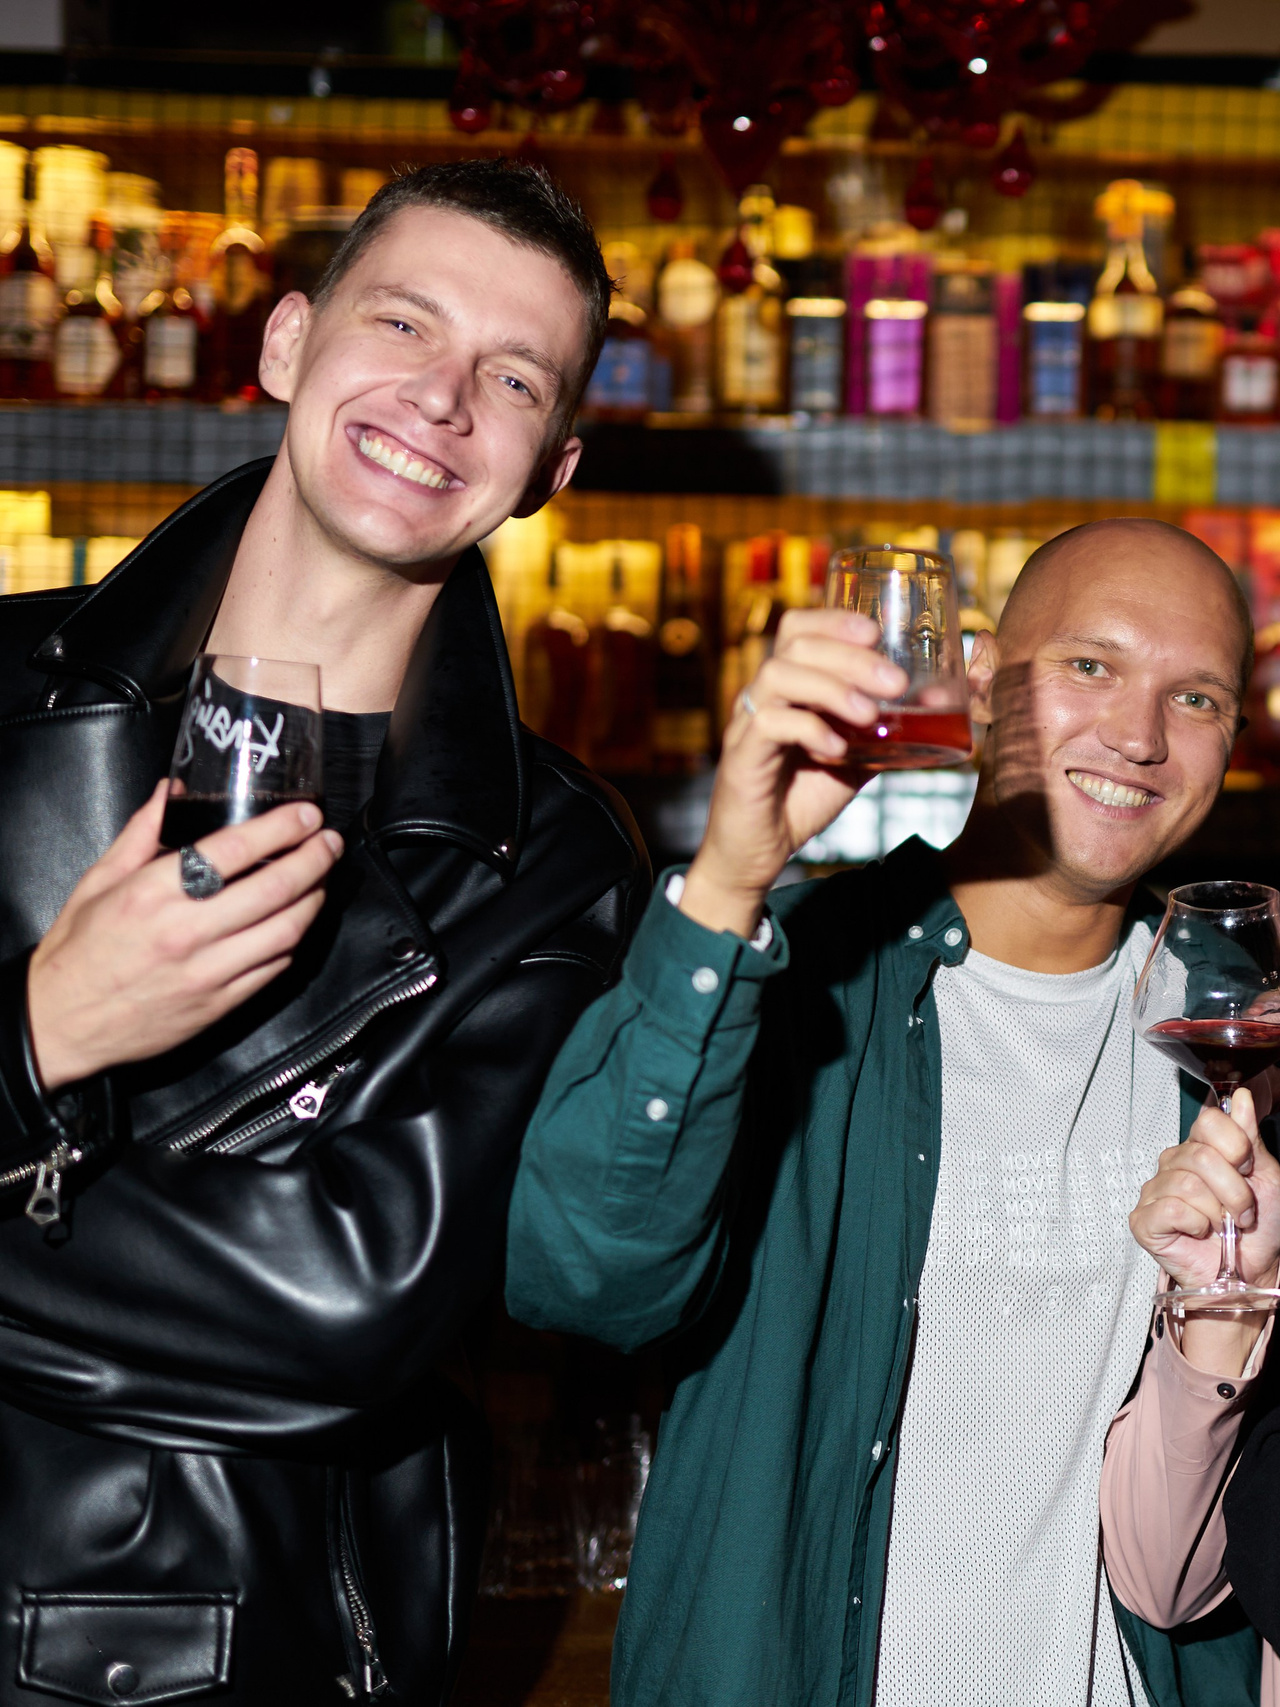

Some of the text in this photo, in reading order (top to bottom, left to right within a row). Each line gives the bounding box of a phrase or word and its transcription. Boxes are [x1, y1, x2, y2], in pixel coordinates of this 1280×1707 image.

[964, 1150, 987, 1166] UP
[1001, 1150, 1057, 1171] MOVE
[1099, 1148, 1144, 1167] KID
[965, 1174, 989, 1191] UP
[1003, 1173, 1059, 1193] MOVE
[966, 1198, 991, 1215] UP
[1006, 1197, 1060, 1217] MOVE
[1070, 1199, 1094, 1217] BE
[968, 1223, 993, 1240] UP
[1009, 1222, 1060, 1241] MOVE
[1073, 1223, 1098, 1241] BE
[967, 1247, 993, 1265] UP
[1009, 1247, 1061, 1266] MOVE
[1077, 1247, 1101, 1265] BE
